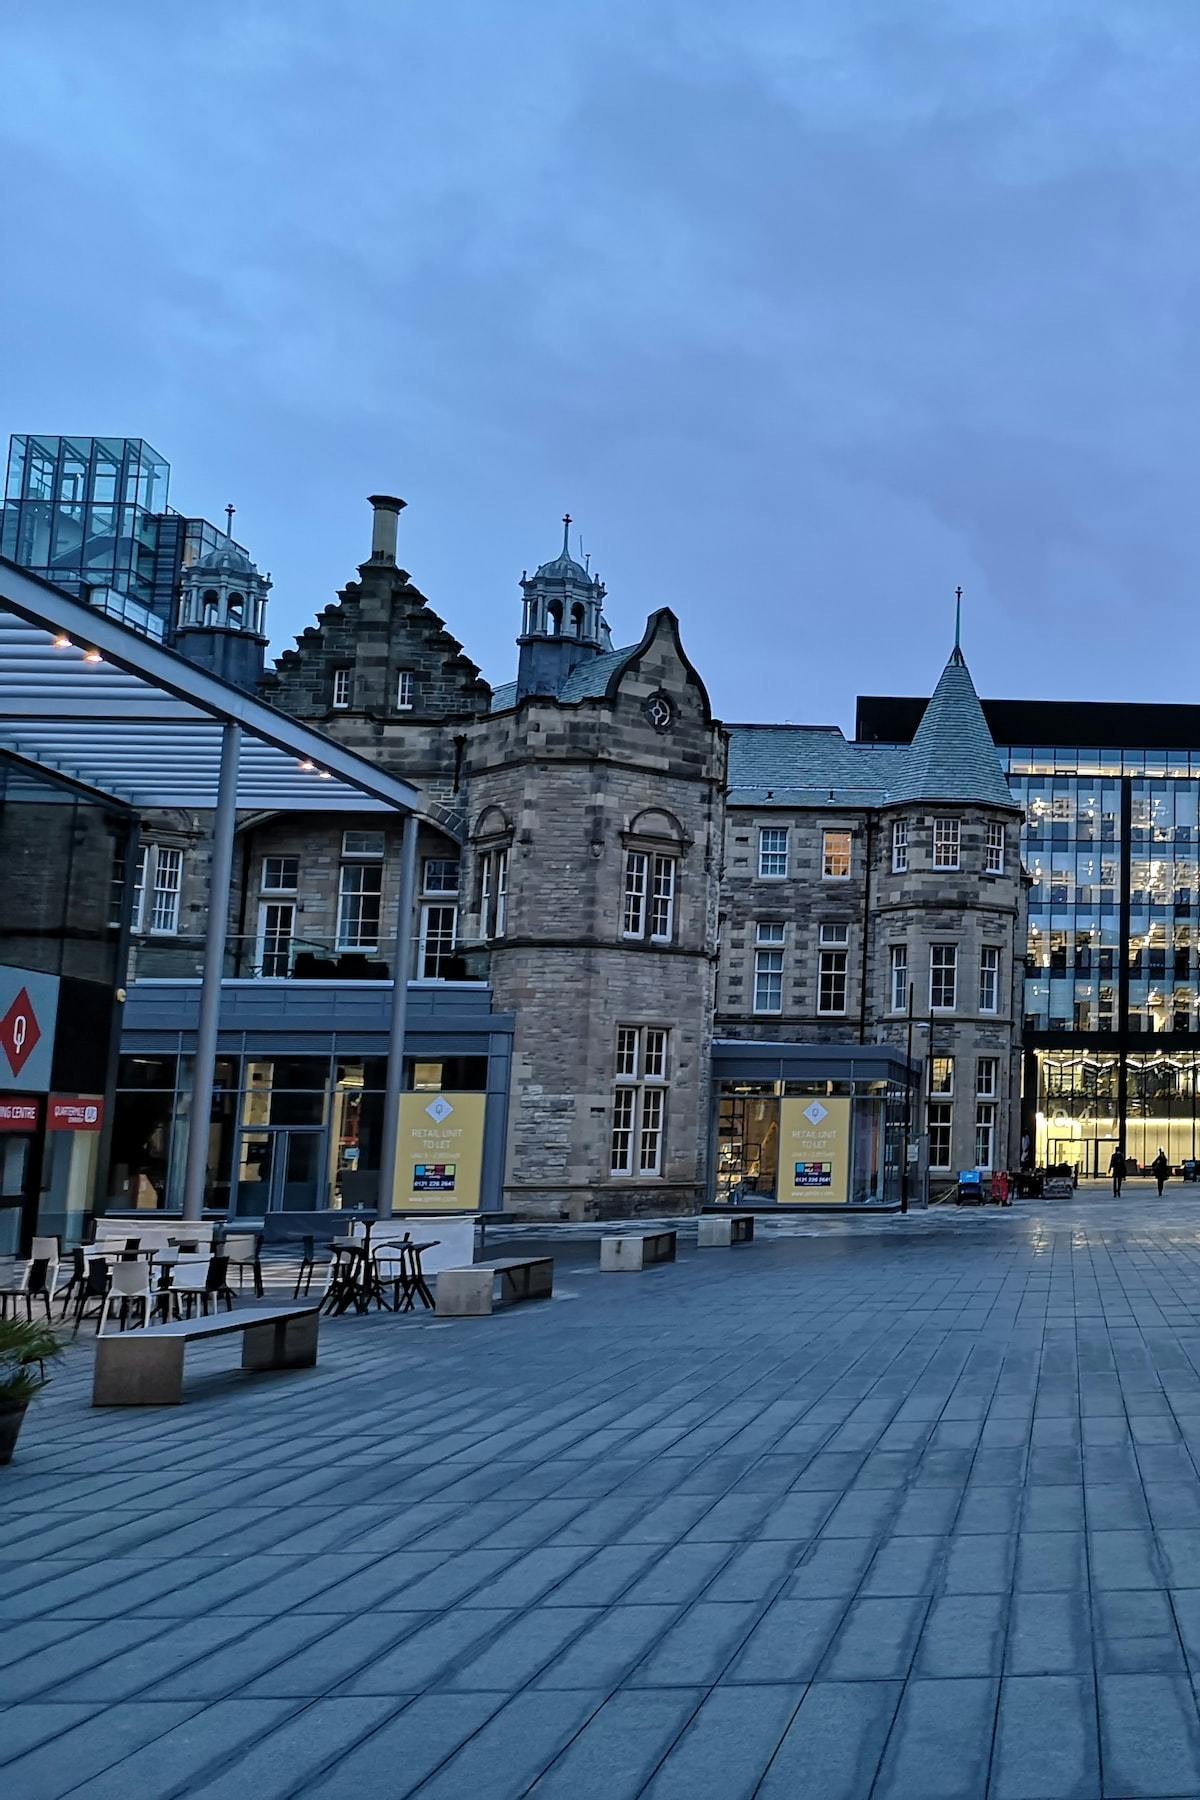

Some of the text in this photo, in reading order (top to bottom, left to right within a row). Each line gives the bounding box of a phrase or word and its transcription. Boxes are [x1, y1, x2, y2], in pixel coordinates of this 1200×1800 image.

[13, 1015, 27, 1054] Q
[12, 1106, 36, 1119] CENTRE
[411, 1129, 463, 1138] RETAIL UNIT
[791, 1130, 837, 1139] RETAIL UNIT
[423, 1140, 450, 1149] TO LET
[802, 1140, 826, 1149] TO LET
